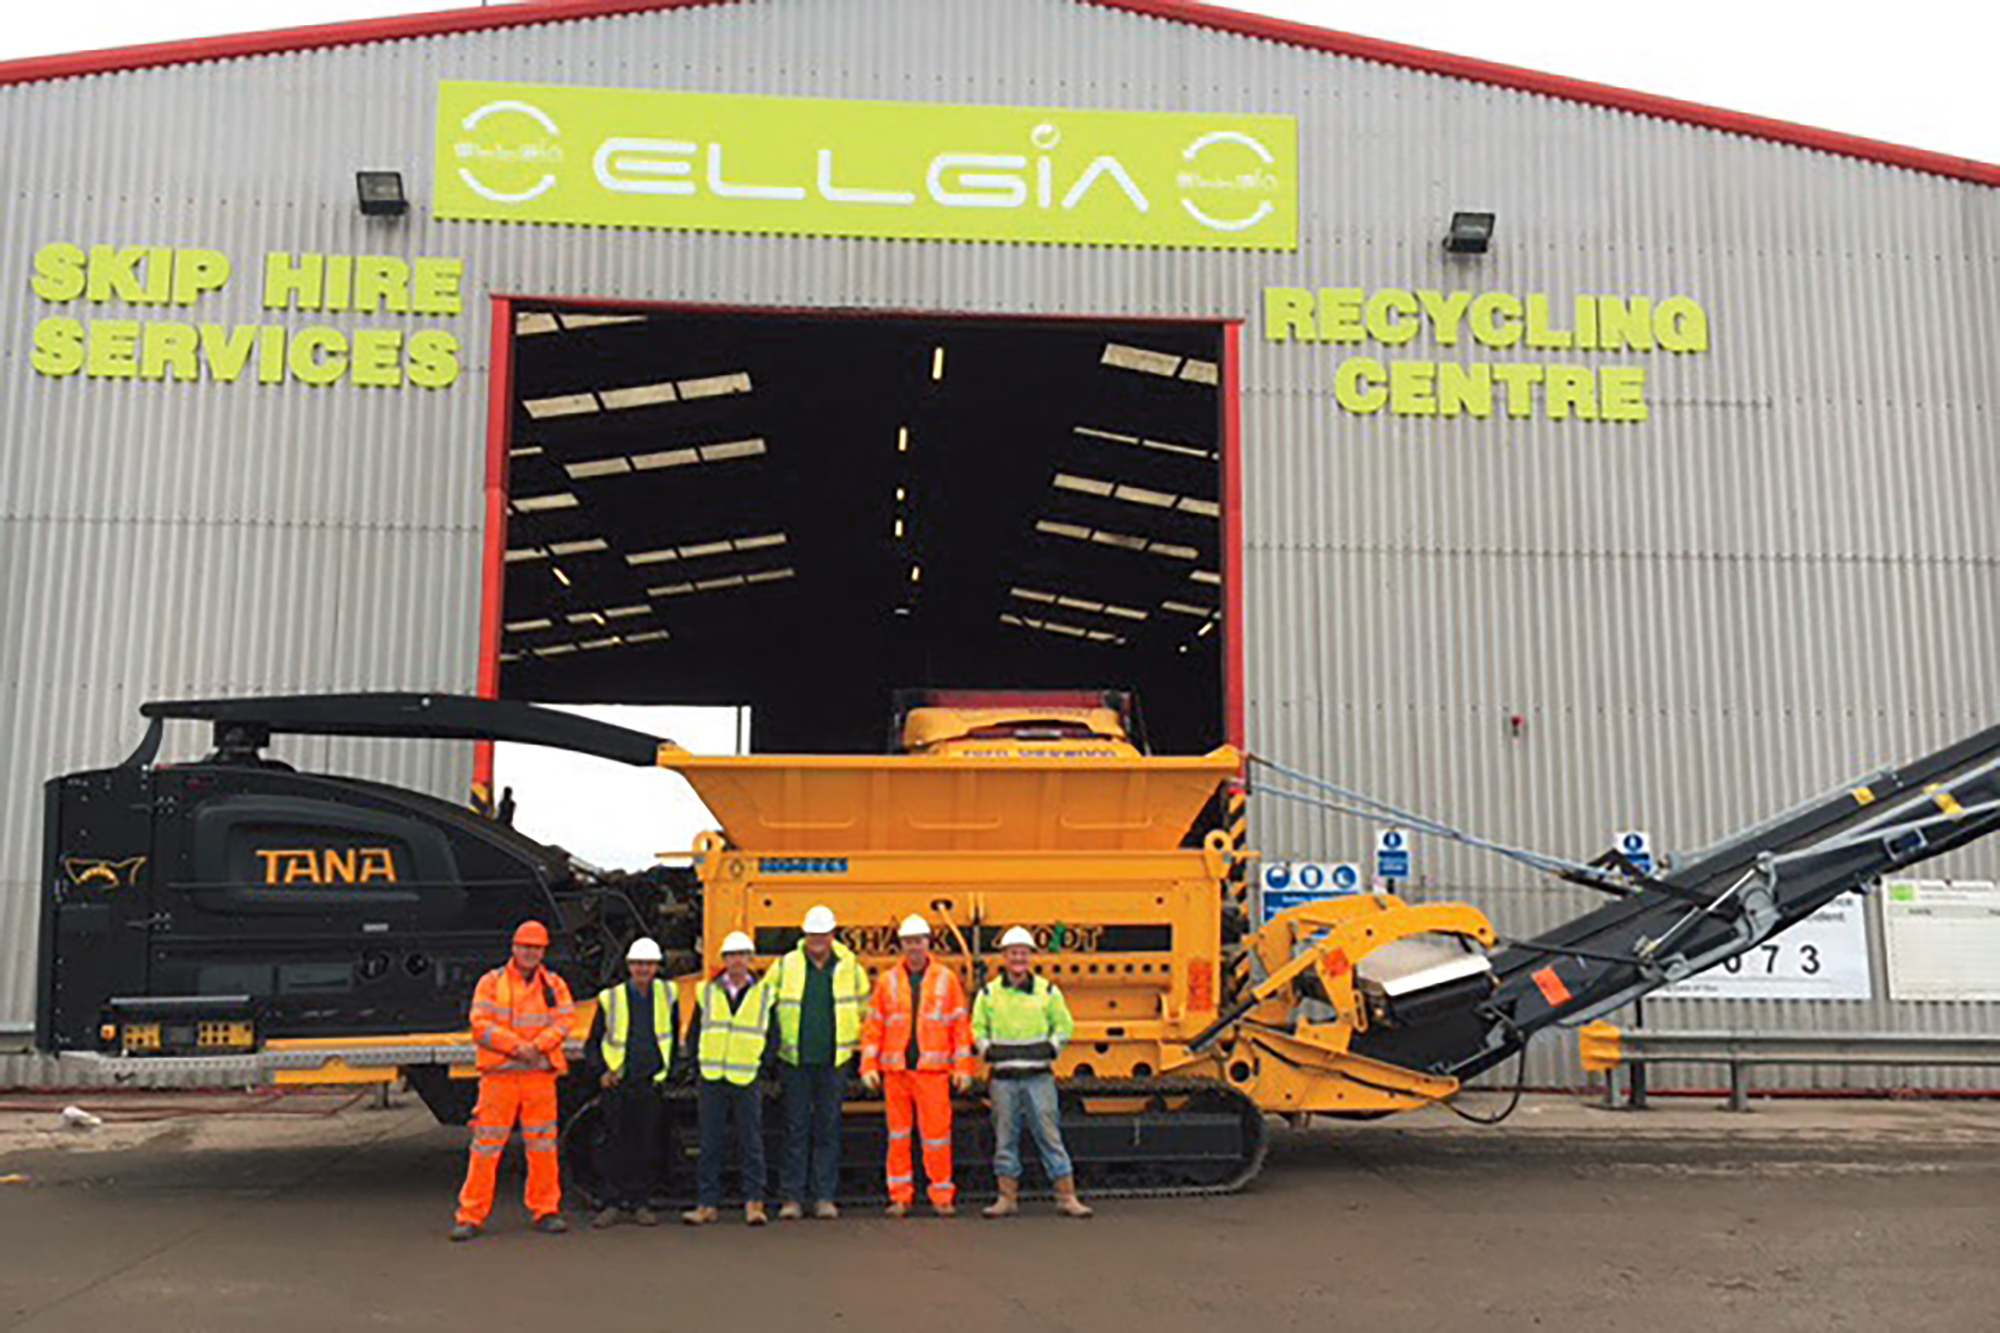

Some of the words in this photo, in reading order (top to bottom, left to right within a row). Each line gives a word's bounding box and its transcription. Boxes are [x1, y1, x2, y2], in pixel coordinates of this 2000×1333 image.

[31, 243, 232, 305] SKIP
[263, 250, 466, 315] HIRE
[1264, 286, 1710, 352] RECYCLING
[30, 316, 463, 389] SERVICES
[1334, 356, 1650, 421] CENTRE
[256, 848, 398, 883] TANA
[841, 917, 952, 952] SHAK
